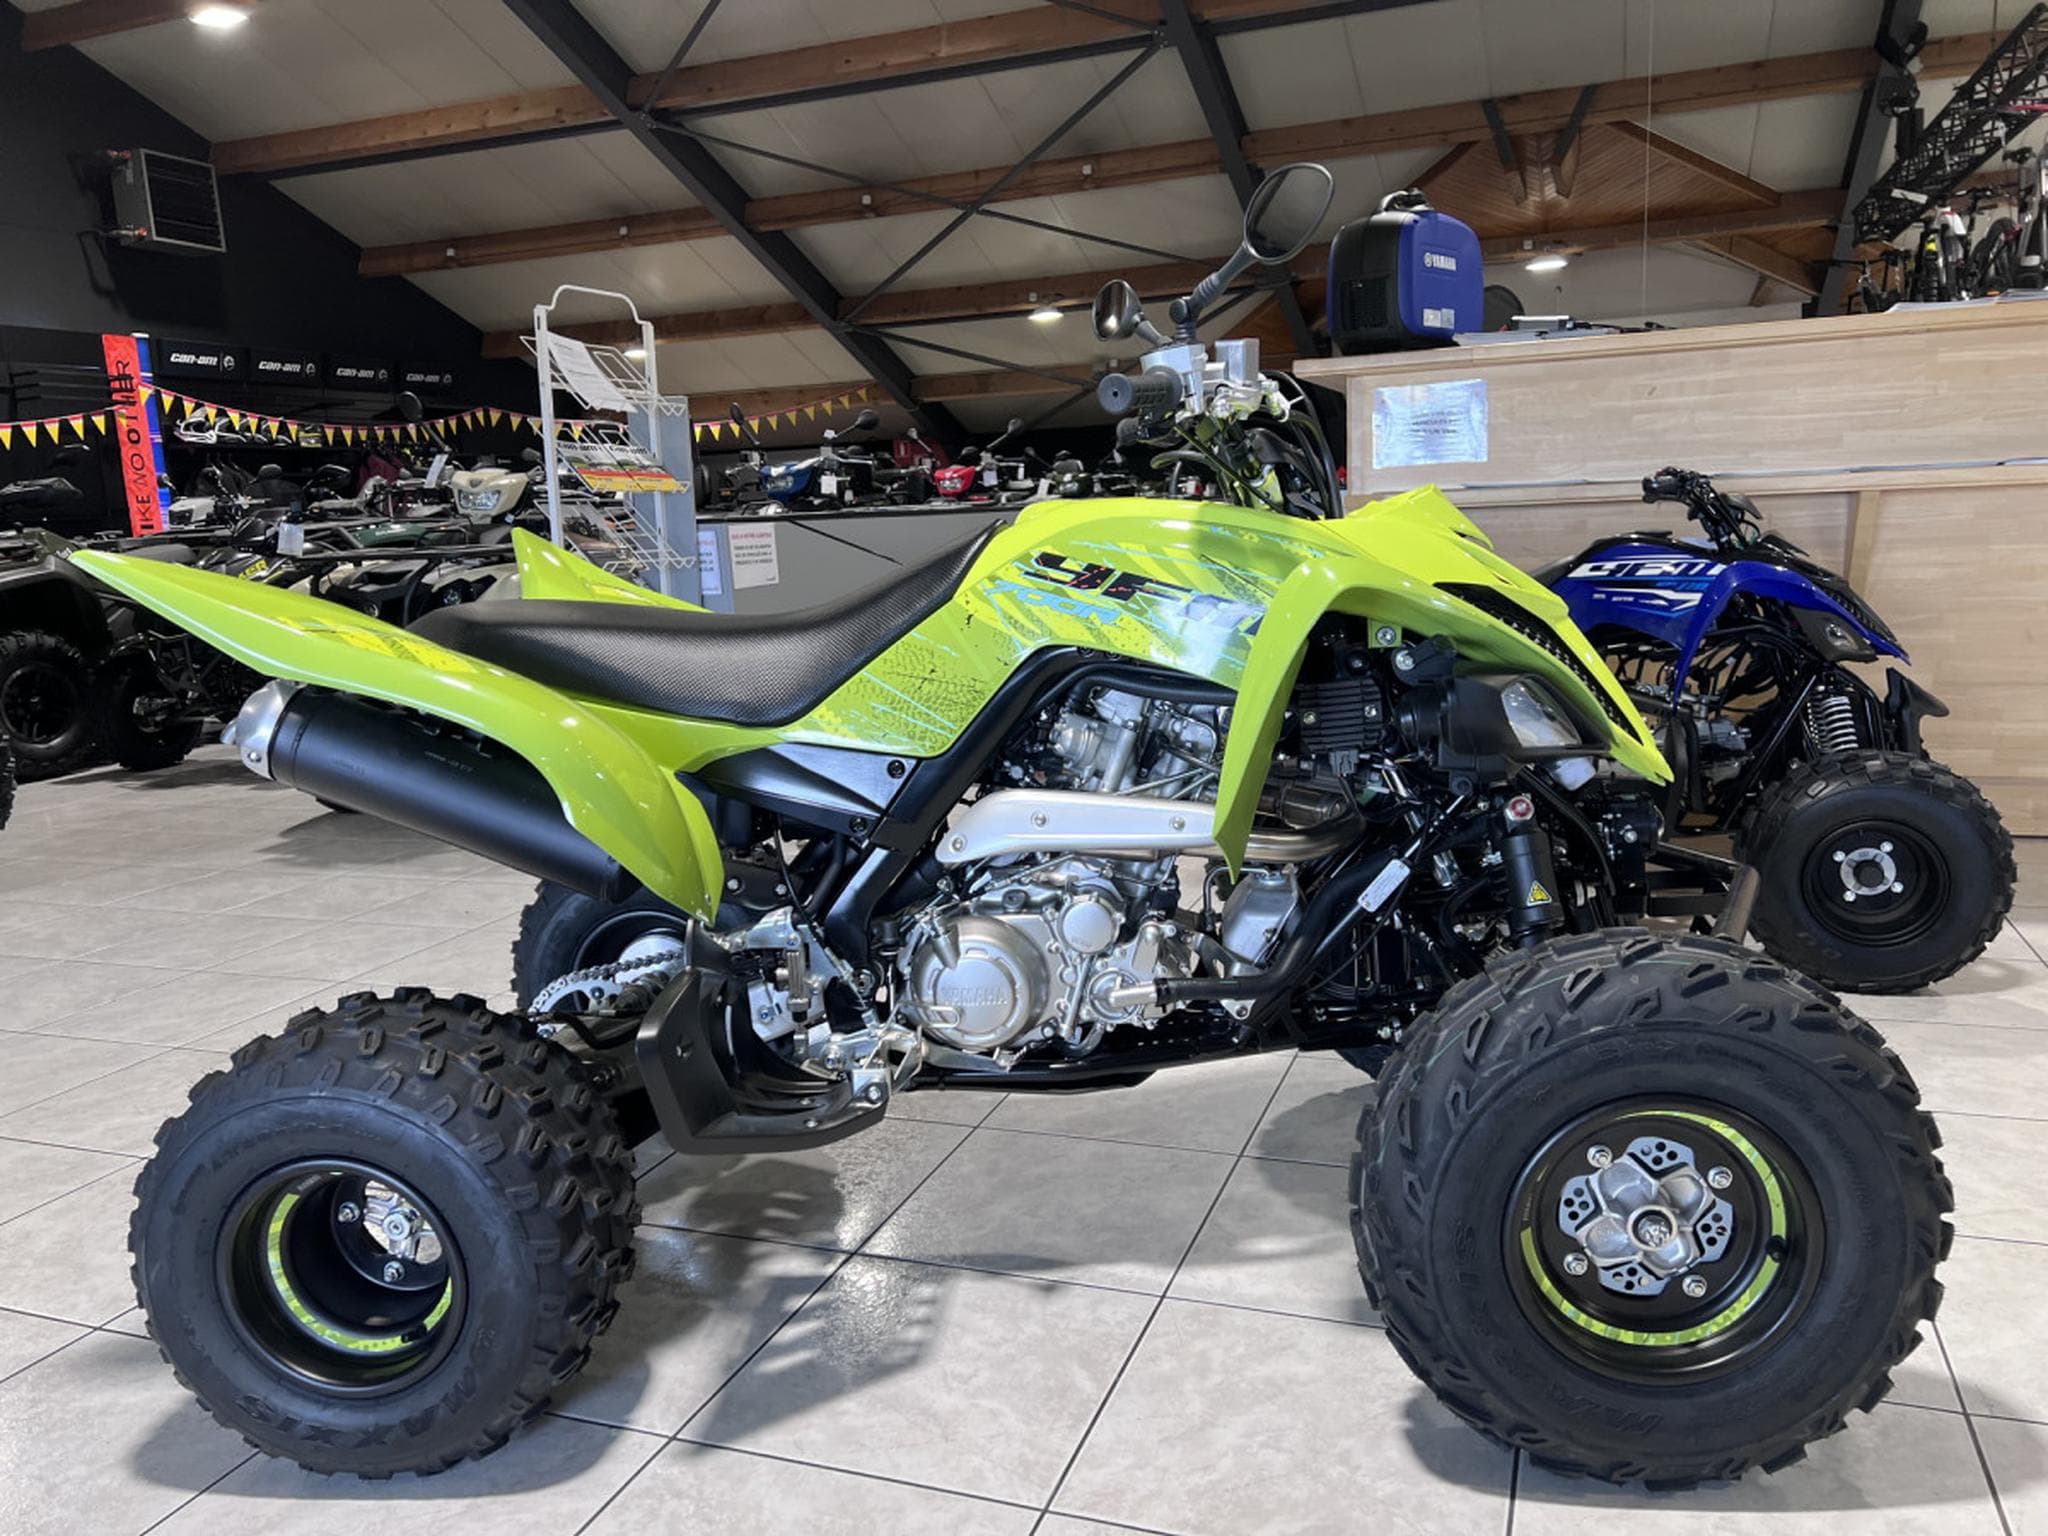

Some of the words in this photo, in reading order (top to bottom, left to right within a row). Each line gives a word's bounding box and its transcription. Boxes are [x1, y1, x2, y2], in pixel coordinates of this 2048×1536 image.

[170, 353, 218, 366] can-am
[258, 361, 301, 372] can-am
[336, 368, 375, 379] can-am
[941, 985, 1008, 1006] YAMAHA
